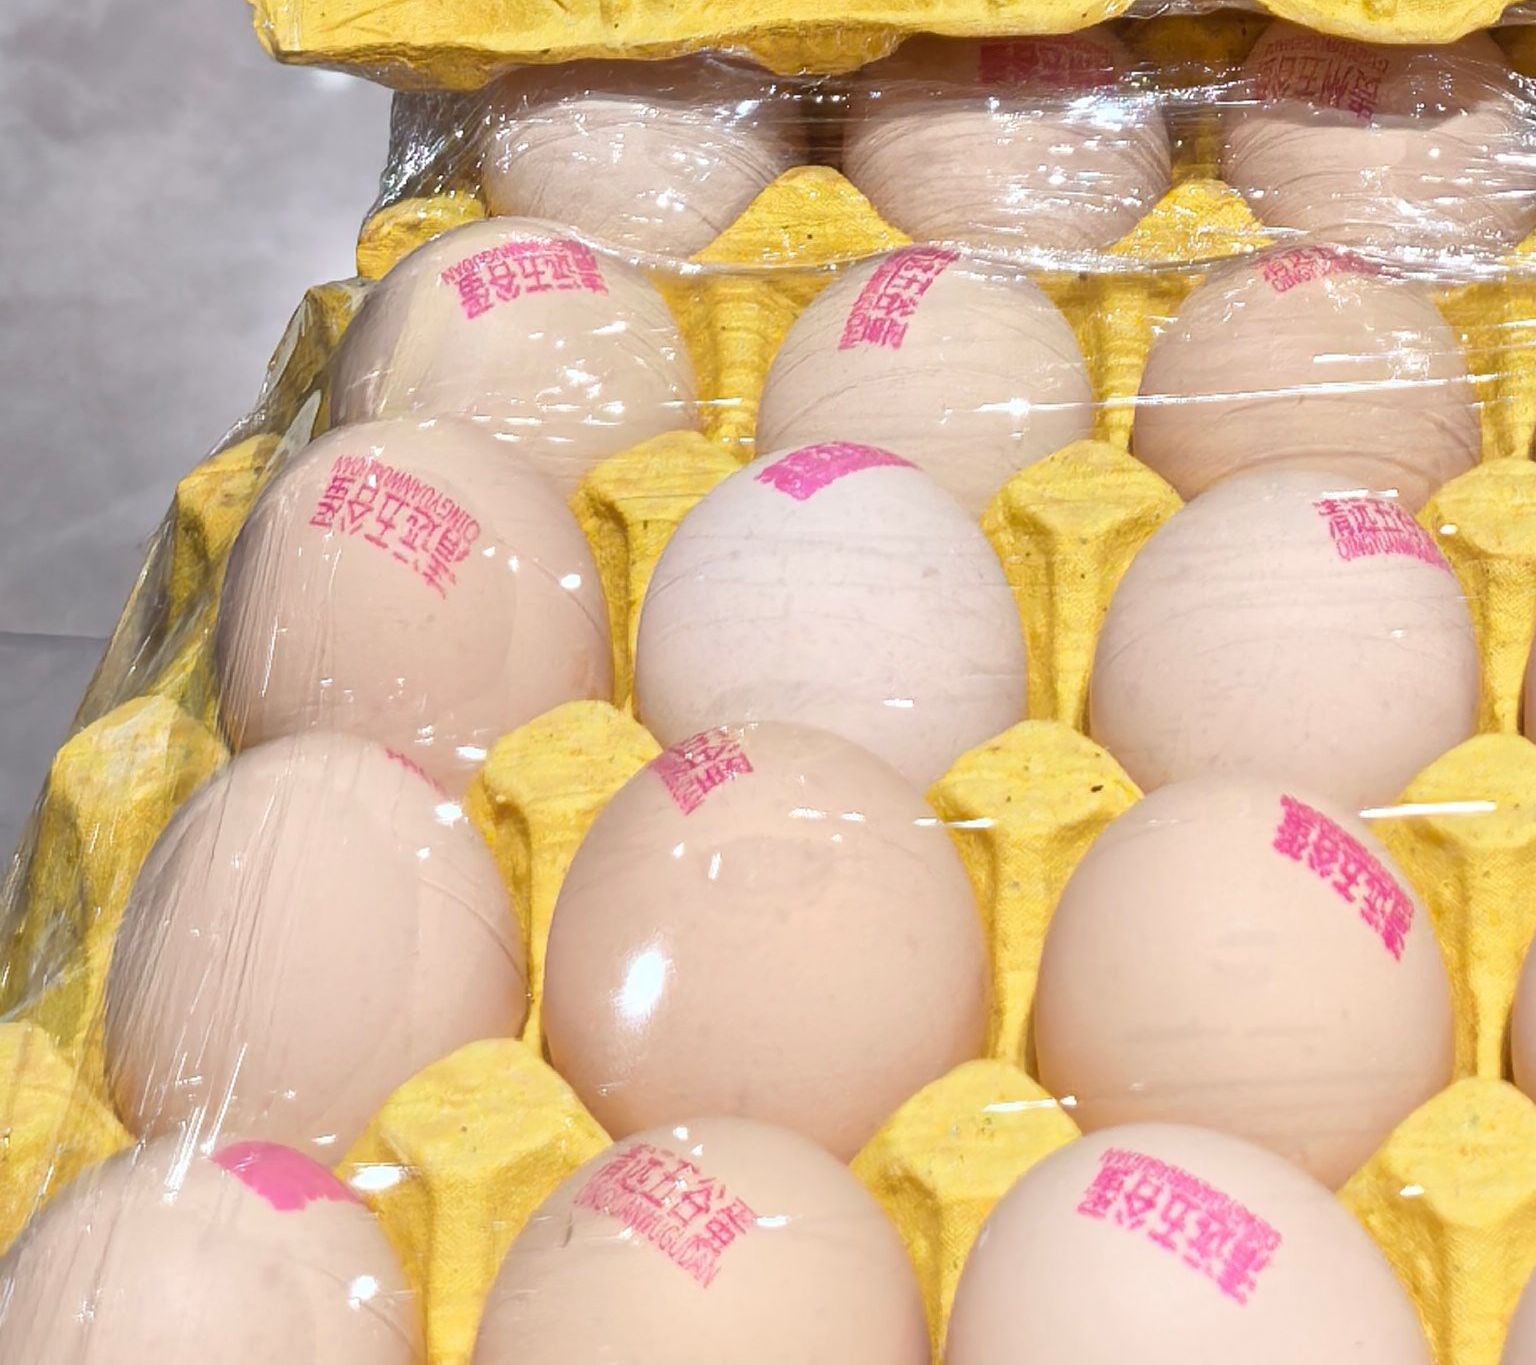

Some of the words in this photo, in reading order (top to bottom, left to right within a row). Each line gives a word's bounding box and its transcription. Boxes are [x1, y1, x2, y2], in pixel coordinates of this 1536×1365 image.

[309, 473, 471, 599] 清远五谷蛋
